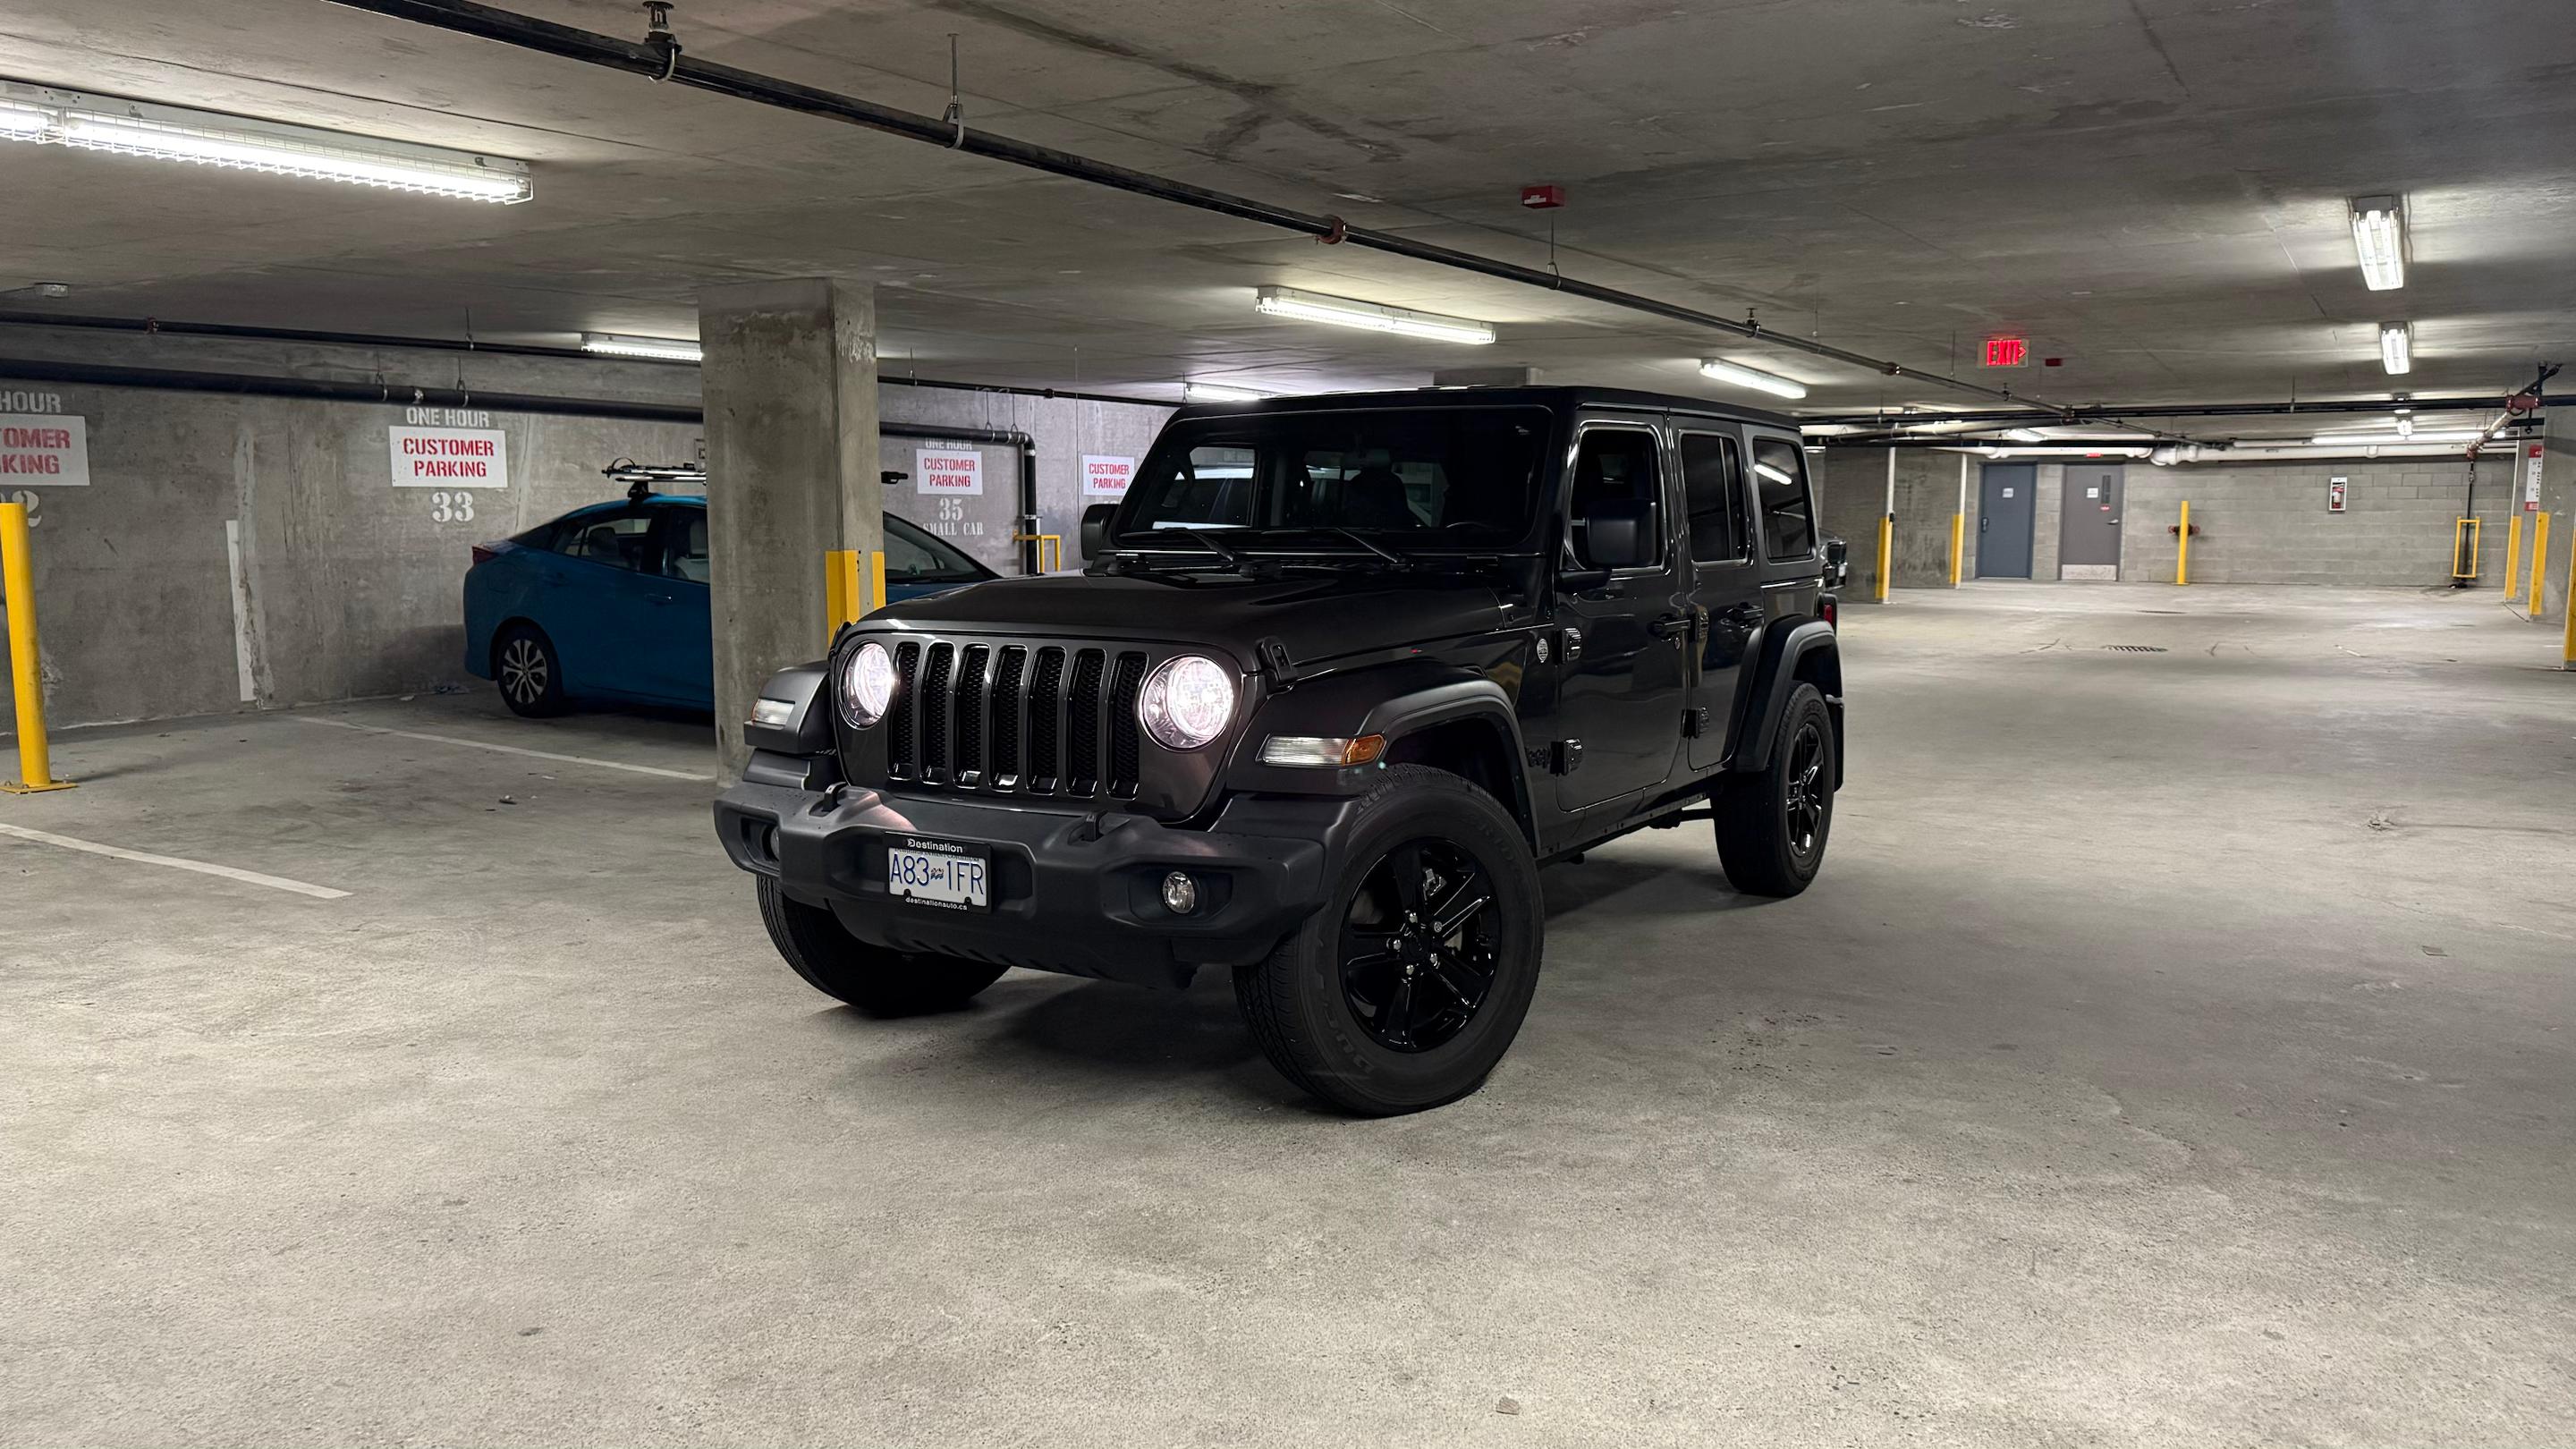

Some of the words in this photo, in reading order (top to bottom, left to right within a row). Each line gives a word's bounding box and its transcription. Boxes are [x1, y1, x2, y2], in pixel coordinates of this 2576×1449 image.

[1987, 339, 2021, 366] EXIT
[406, 407, 441, 426] ONE
[445, 409, 490, 428] HOUR
[0, 428, 71, 449] OMER
[402, 437, 495, 457] CUSTOMER
[0, 453, 61, 474] KING
[413, 460, 487, 478] PARKING
[924, 457, 976, 471] CUSTOMER
[1089, 463, 1130, 475] CUSTOMER
[929, 474, 971, 487] PARKING
[1093, 478, 1126, 489] PARKING
[432, 492, 475, 522] 33
[939, 498, 963, 521] 35
[923, 522, 958, 536] SMALL
[962, 522, 984, 536] CAR
[907, 838, 963, 853] Destination
[891, 853, 929, 886] A83
[905, 896, 968, 911] destinationauto.ca
